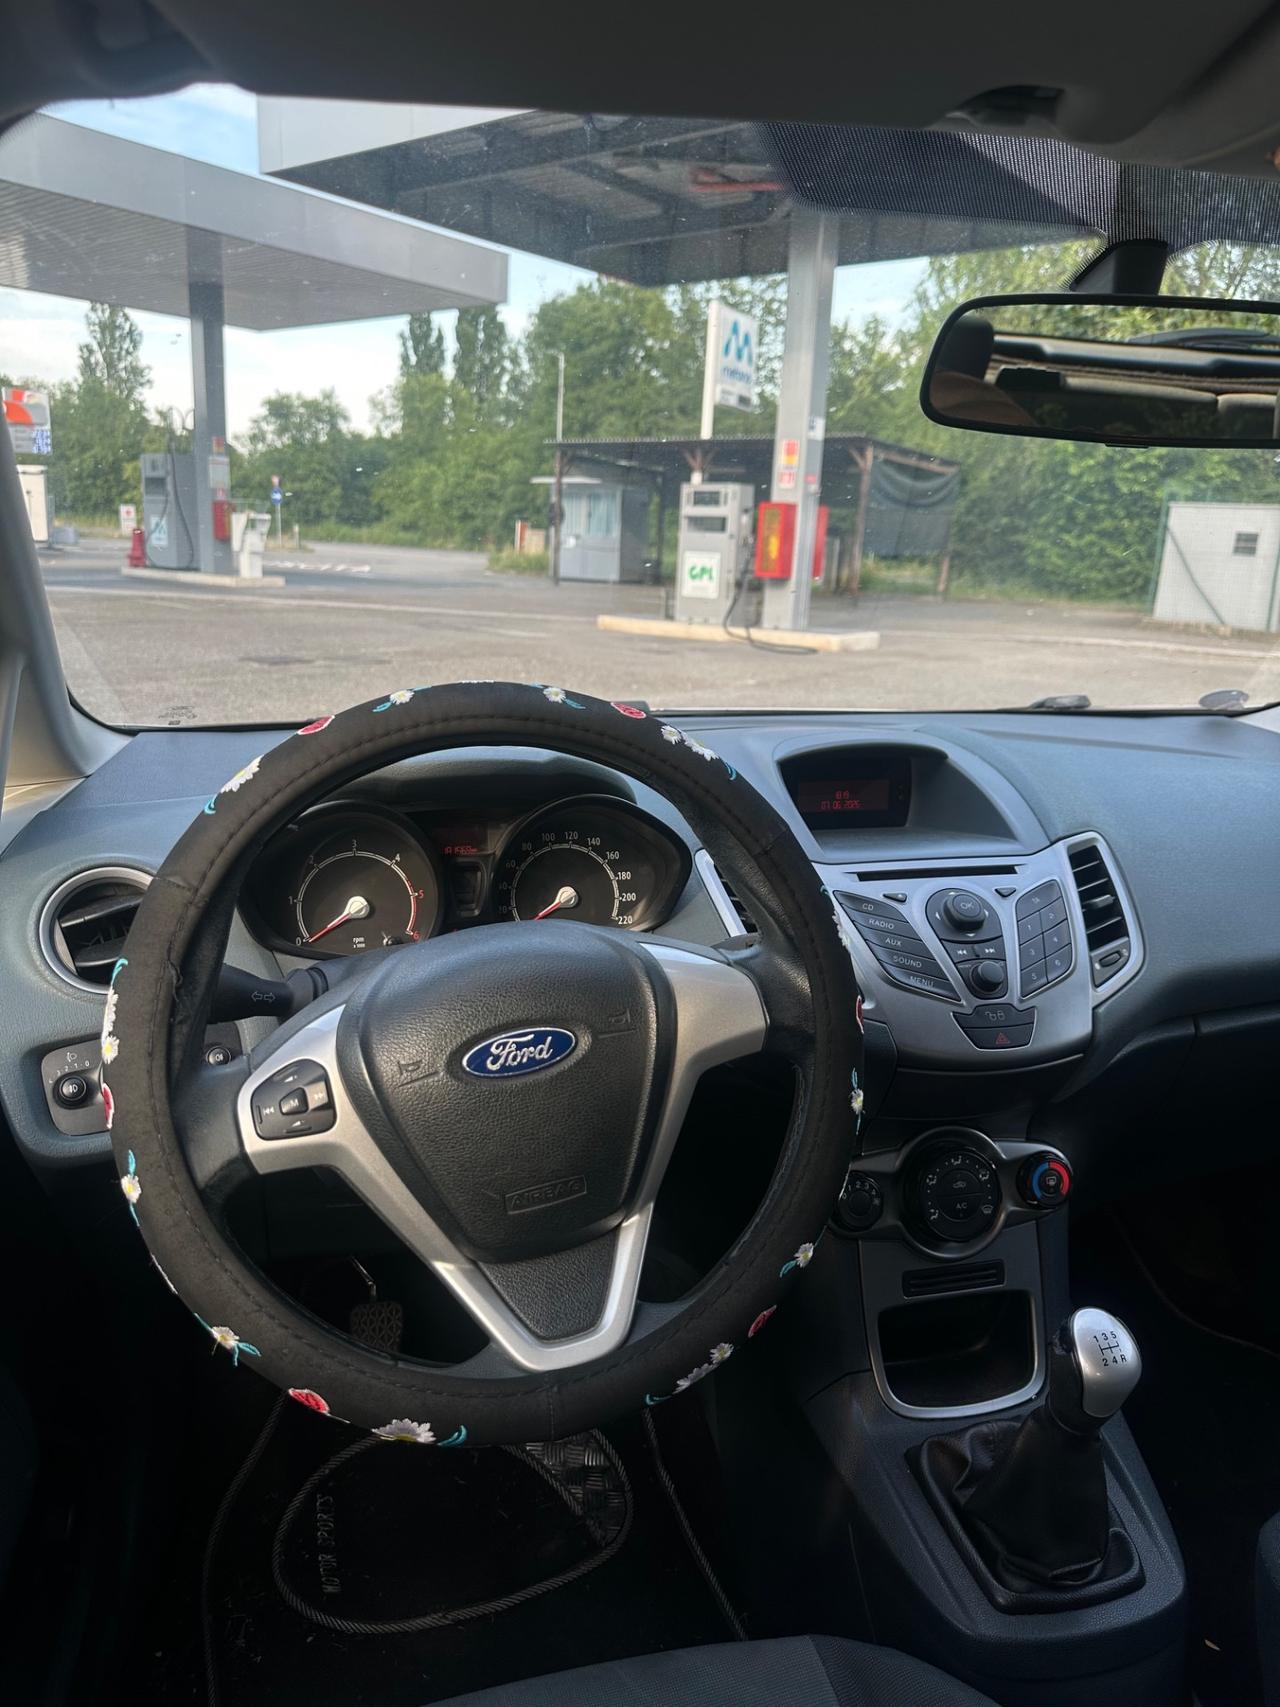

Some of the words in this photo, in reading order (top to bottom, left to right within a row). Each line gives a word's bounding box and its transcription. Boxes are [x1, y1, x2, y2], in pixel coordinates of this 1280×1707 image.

[542, 832, 555, 841] 100
[565, 831, 579, 840] 120
[587, 837, 601, 846] 140
[522, 842, 532, 851] 80
[606, 851, 620, 860] 160
[618, 871, 632, 880] 180
[622, 892, 637, 901] 200
[862, 903, 874, 911] CD
[960, 902, 974, 910] OK
[618, 915, 633, 925] 220
[869, 919, 895, 930] RADIO
[295, 937, 302, 946] 0
[885, 937, 902, 946] AUX
[893, 955, 922, 968] SOUND
[910, 975, 934, 987] MENU
[486, 1034, 553, 1071] Ford
[511, 1180, 580, 1208] AIRBAG
[1101, 1332, 1109, 1341] 3
[1110, 1331, 1117, 1339] 5
[1102, 1357, 1109, 1367] 2
[1112, 1355, 1118, 1364] 4
[1120, 1354, 1127, 1363] R
